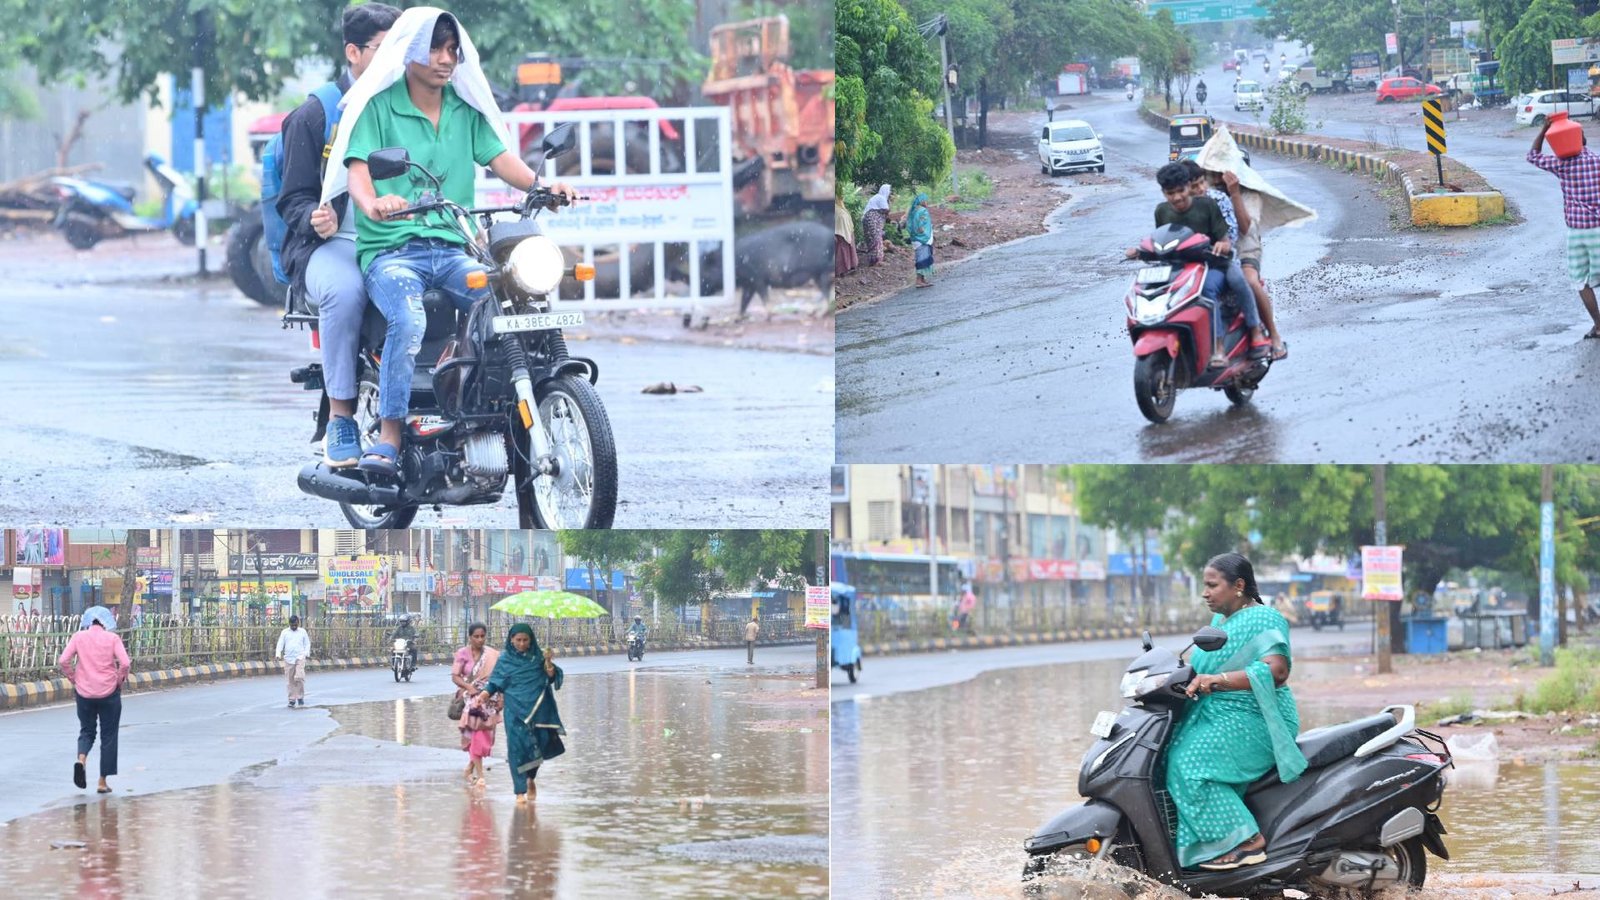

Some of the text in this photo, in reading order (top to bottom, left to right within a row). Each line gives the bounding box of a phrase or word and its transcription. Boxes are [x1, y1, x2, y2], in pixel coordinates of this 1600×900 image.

[328, 570, 374, 578] WHOLESALE
[342, 577, 368, 585] RETAIL
[1541, 567, 1553, 633] BANK
